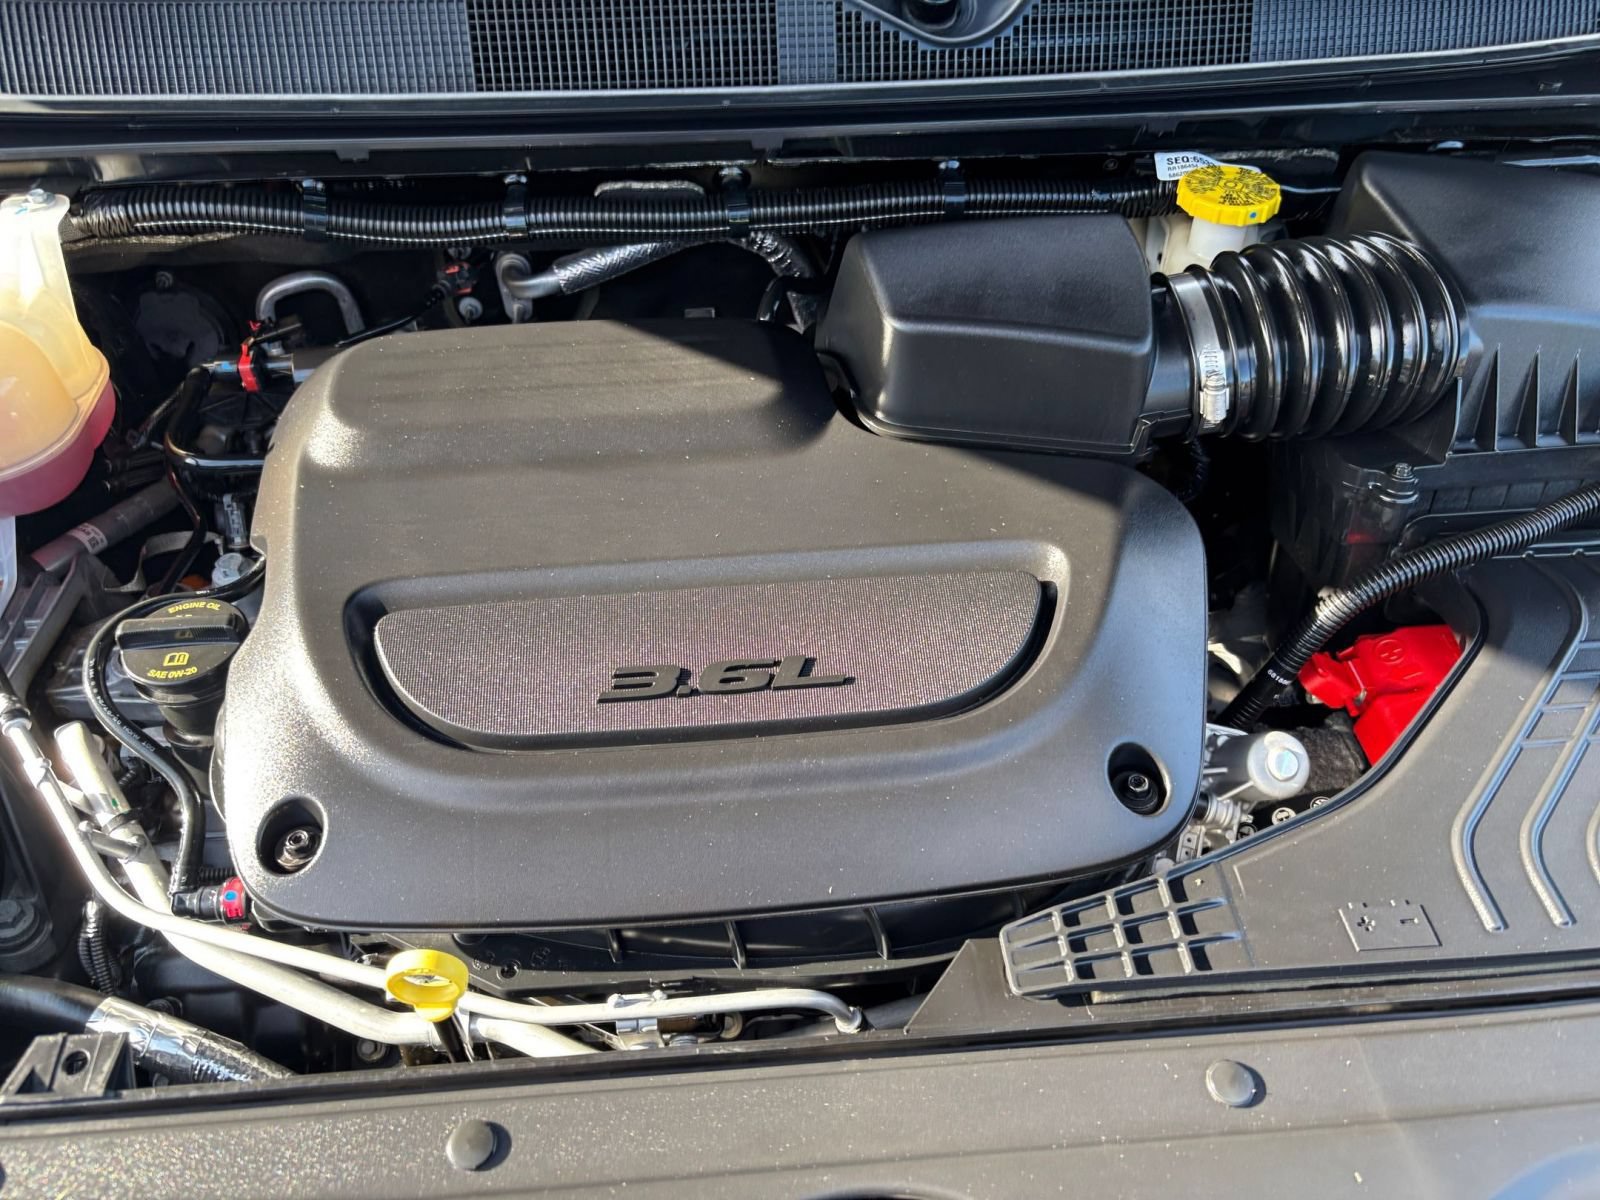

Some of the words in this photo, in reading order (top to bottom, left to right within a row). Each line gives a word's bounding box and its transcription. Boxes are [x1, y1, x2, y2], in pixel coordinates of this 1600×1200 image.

[167, 601, 207, 614] ENGINE
[206, 602, 221, 611] OIL
[147, 668, 169, 679] SAE
[167, 666, 198, 679] 0W-20
[597, 655, 849, 704] 3.6L
